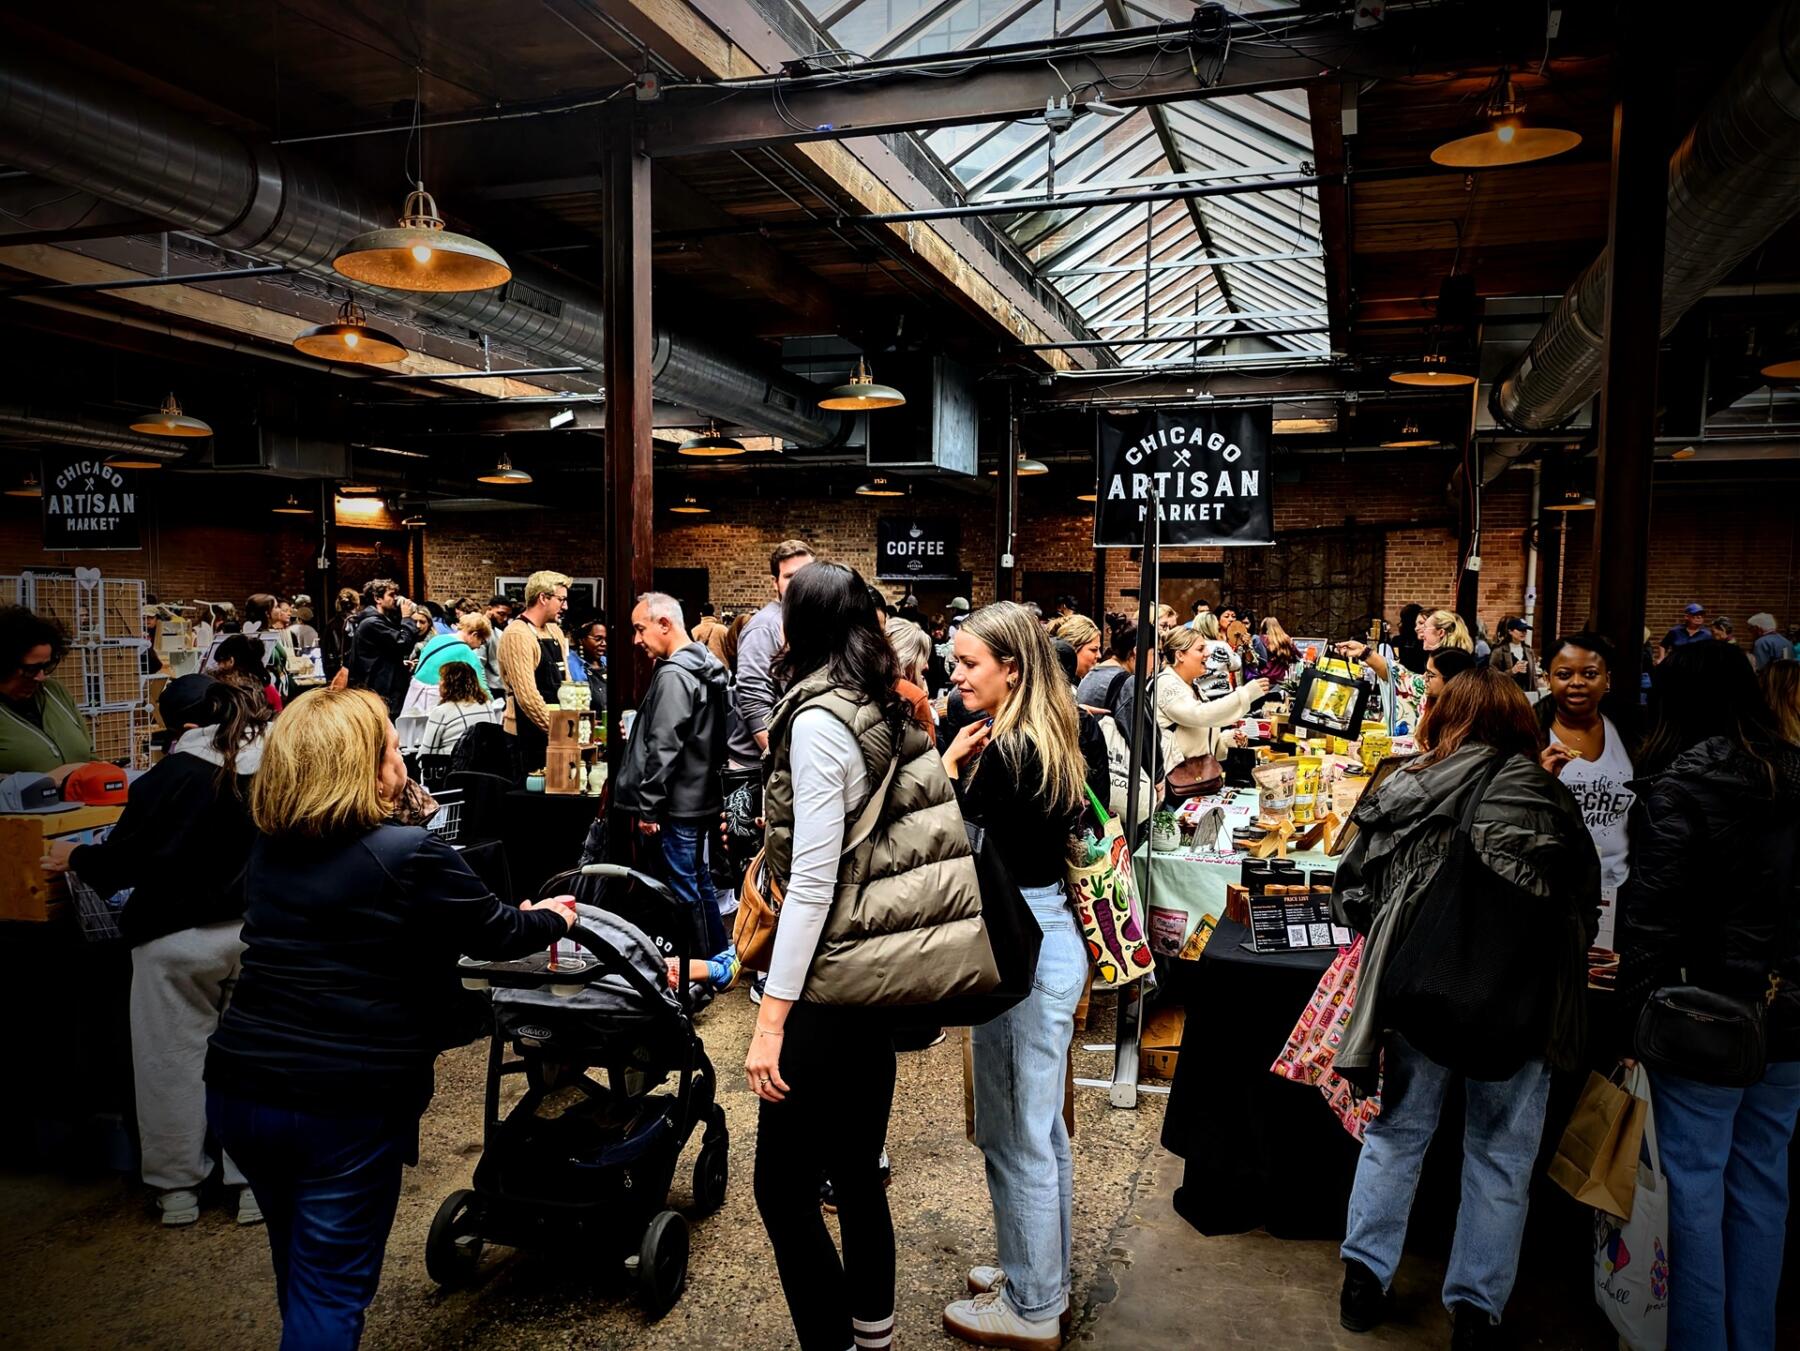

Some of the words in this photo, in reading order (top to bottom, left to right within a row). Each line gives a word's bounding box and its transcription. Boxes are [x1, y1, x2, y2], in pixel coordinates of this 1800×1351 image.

[1125, 426, 1241, 465] CHICAGO
[56, 461, 123, 489] CHICAGO
[1107, 470, 1259, 500] ARTISAN
[48, 493, 135, 514] ARTISAN
[67, 517, 115, 531] MARKET
[886, 541, 944, 555] COFFEE
[1592, 775, 1614, 793] the
